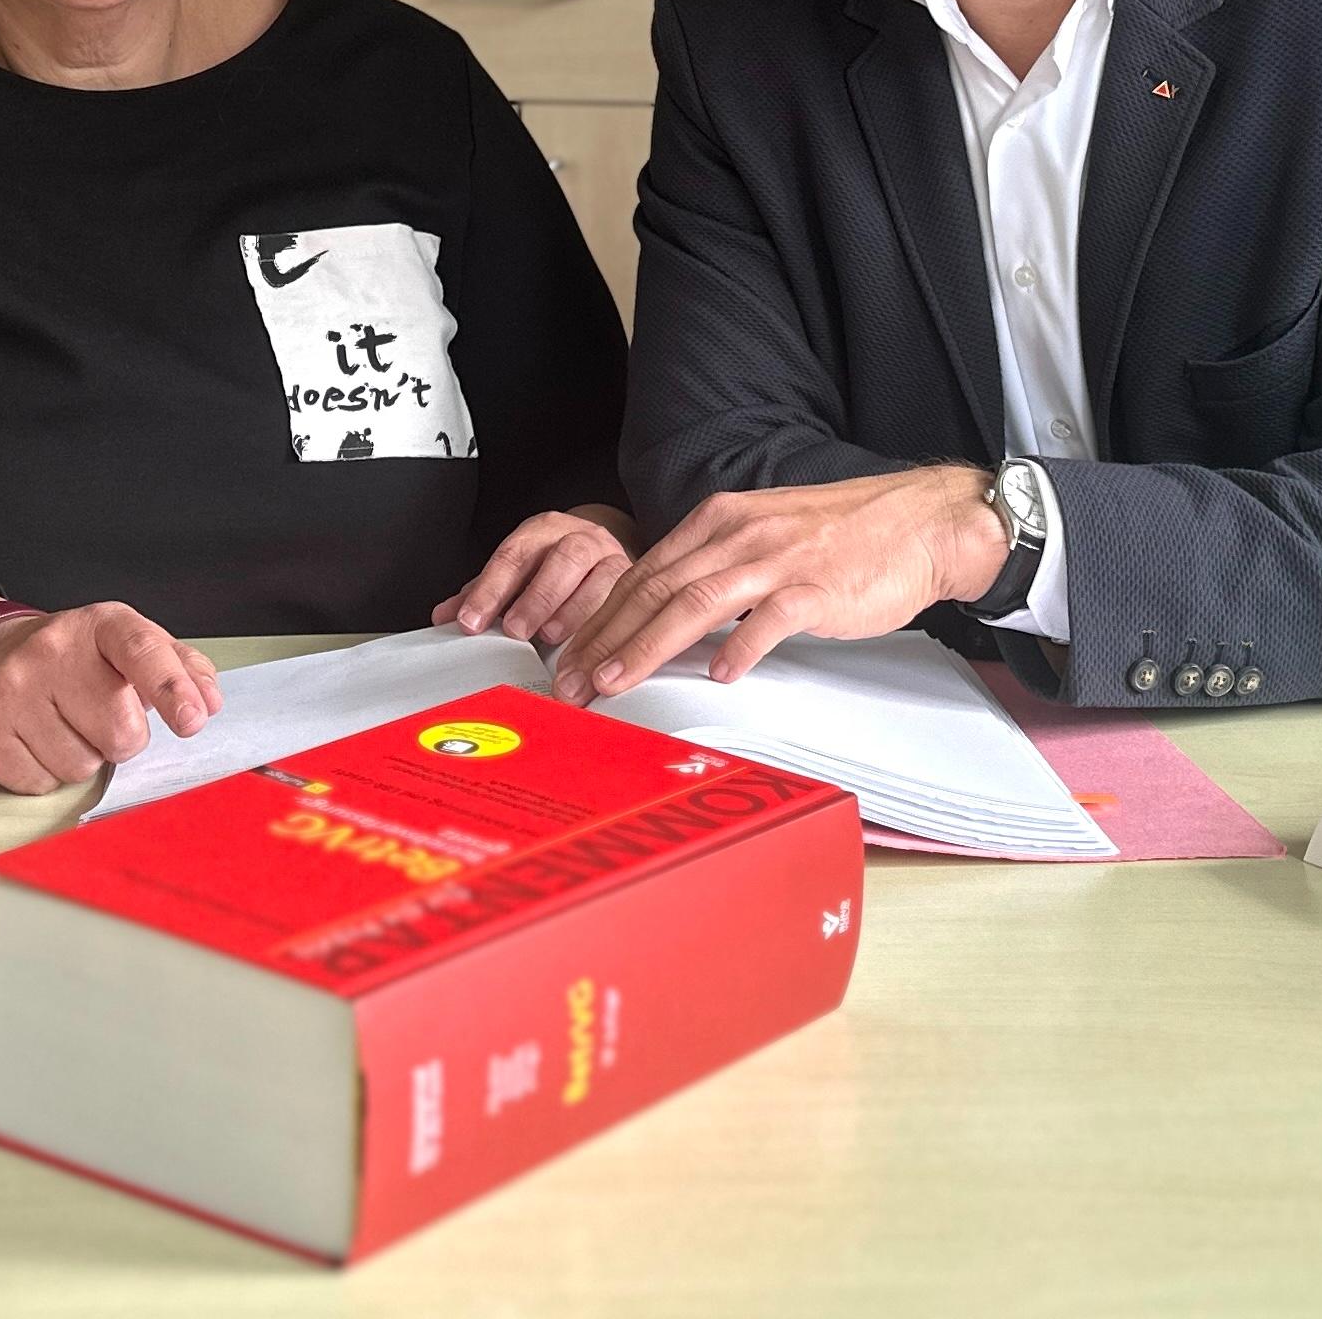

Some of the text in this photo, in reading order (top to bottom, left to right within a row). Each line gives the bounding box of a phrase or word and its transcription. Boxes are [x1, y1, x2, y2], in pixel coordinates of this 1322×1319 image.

[326, 323, 398, 376] it
[269, 812, 461, 883] BetrVG
[321, 770, 814, 978] KOMMENTAR
